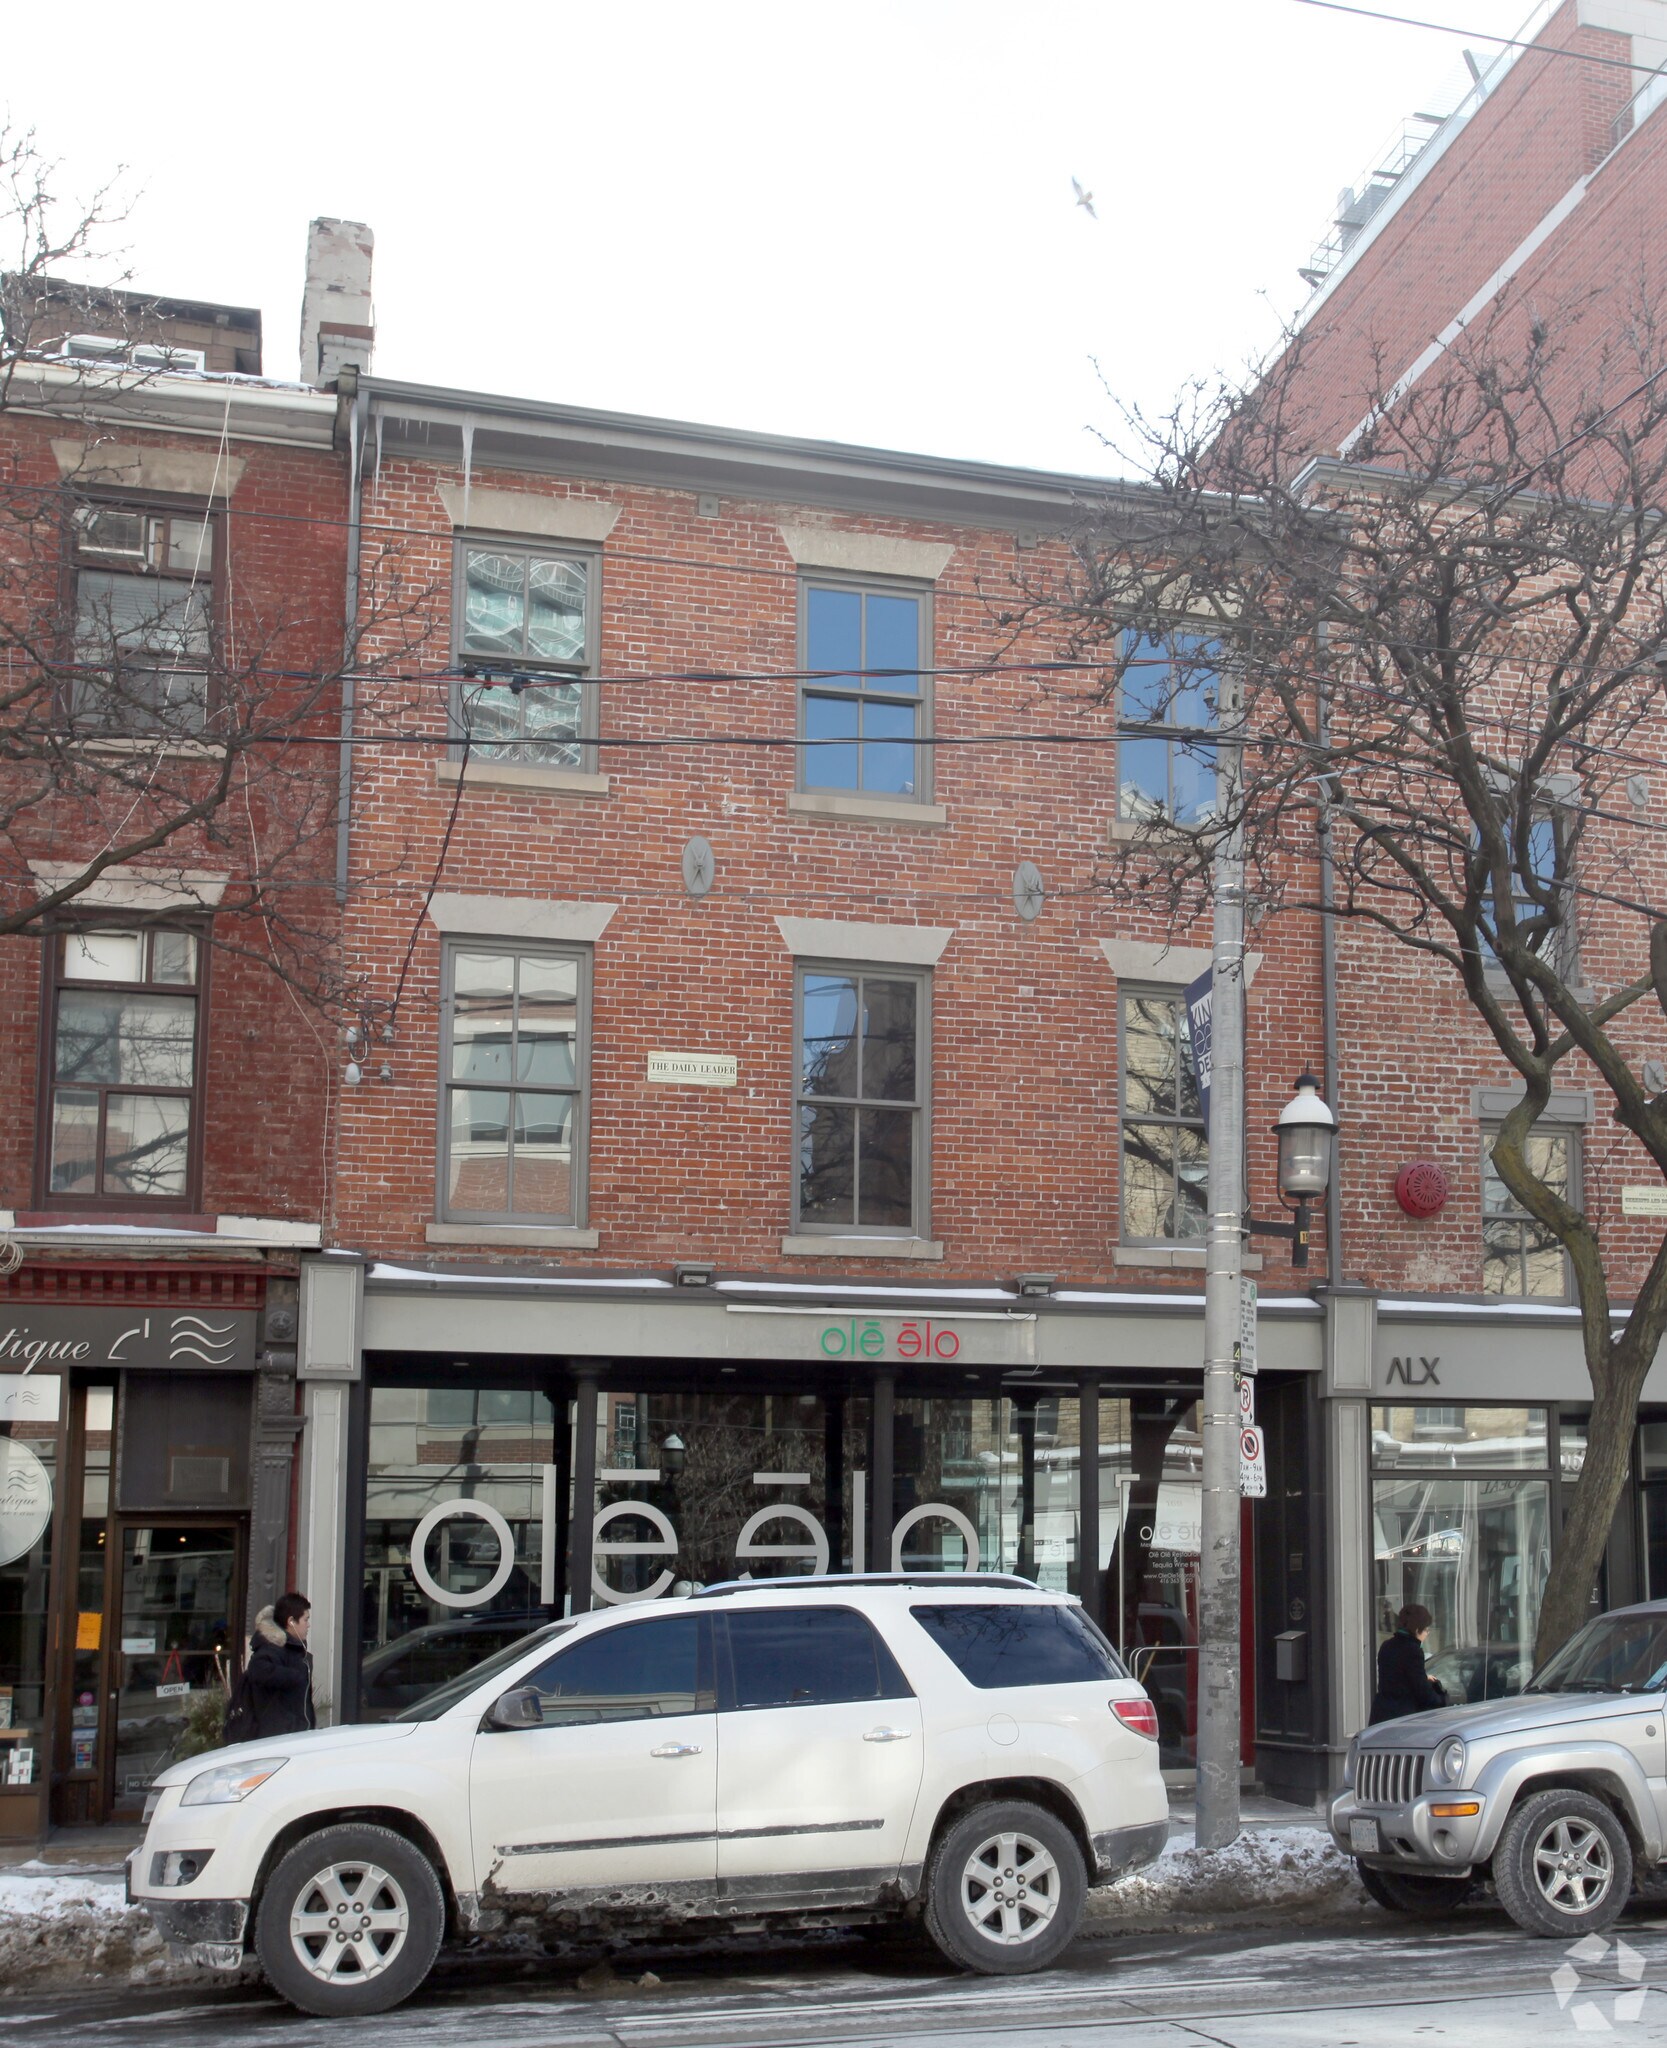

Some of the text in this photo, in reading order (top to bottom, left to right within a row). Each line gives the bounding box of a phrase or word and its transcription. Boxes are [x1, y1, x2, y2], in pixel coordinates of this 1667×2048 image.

[1192, 998, 1212, 1029] KIN
[650, 1061, 669, 1071] THE
[672, 1063, 697, 1073] DAILY
[700, 1064, 736, 1075] LEADER
[1199, 1055, 1211, 1075] DE
[1386, 1356, 1441, 1385] ALX
[163, 1686, 184, 1694] OPEN
